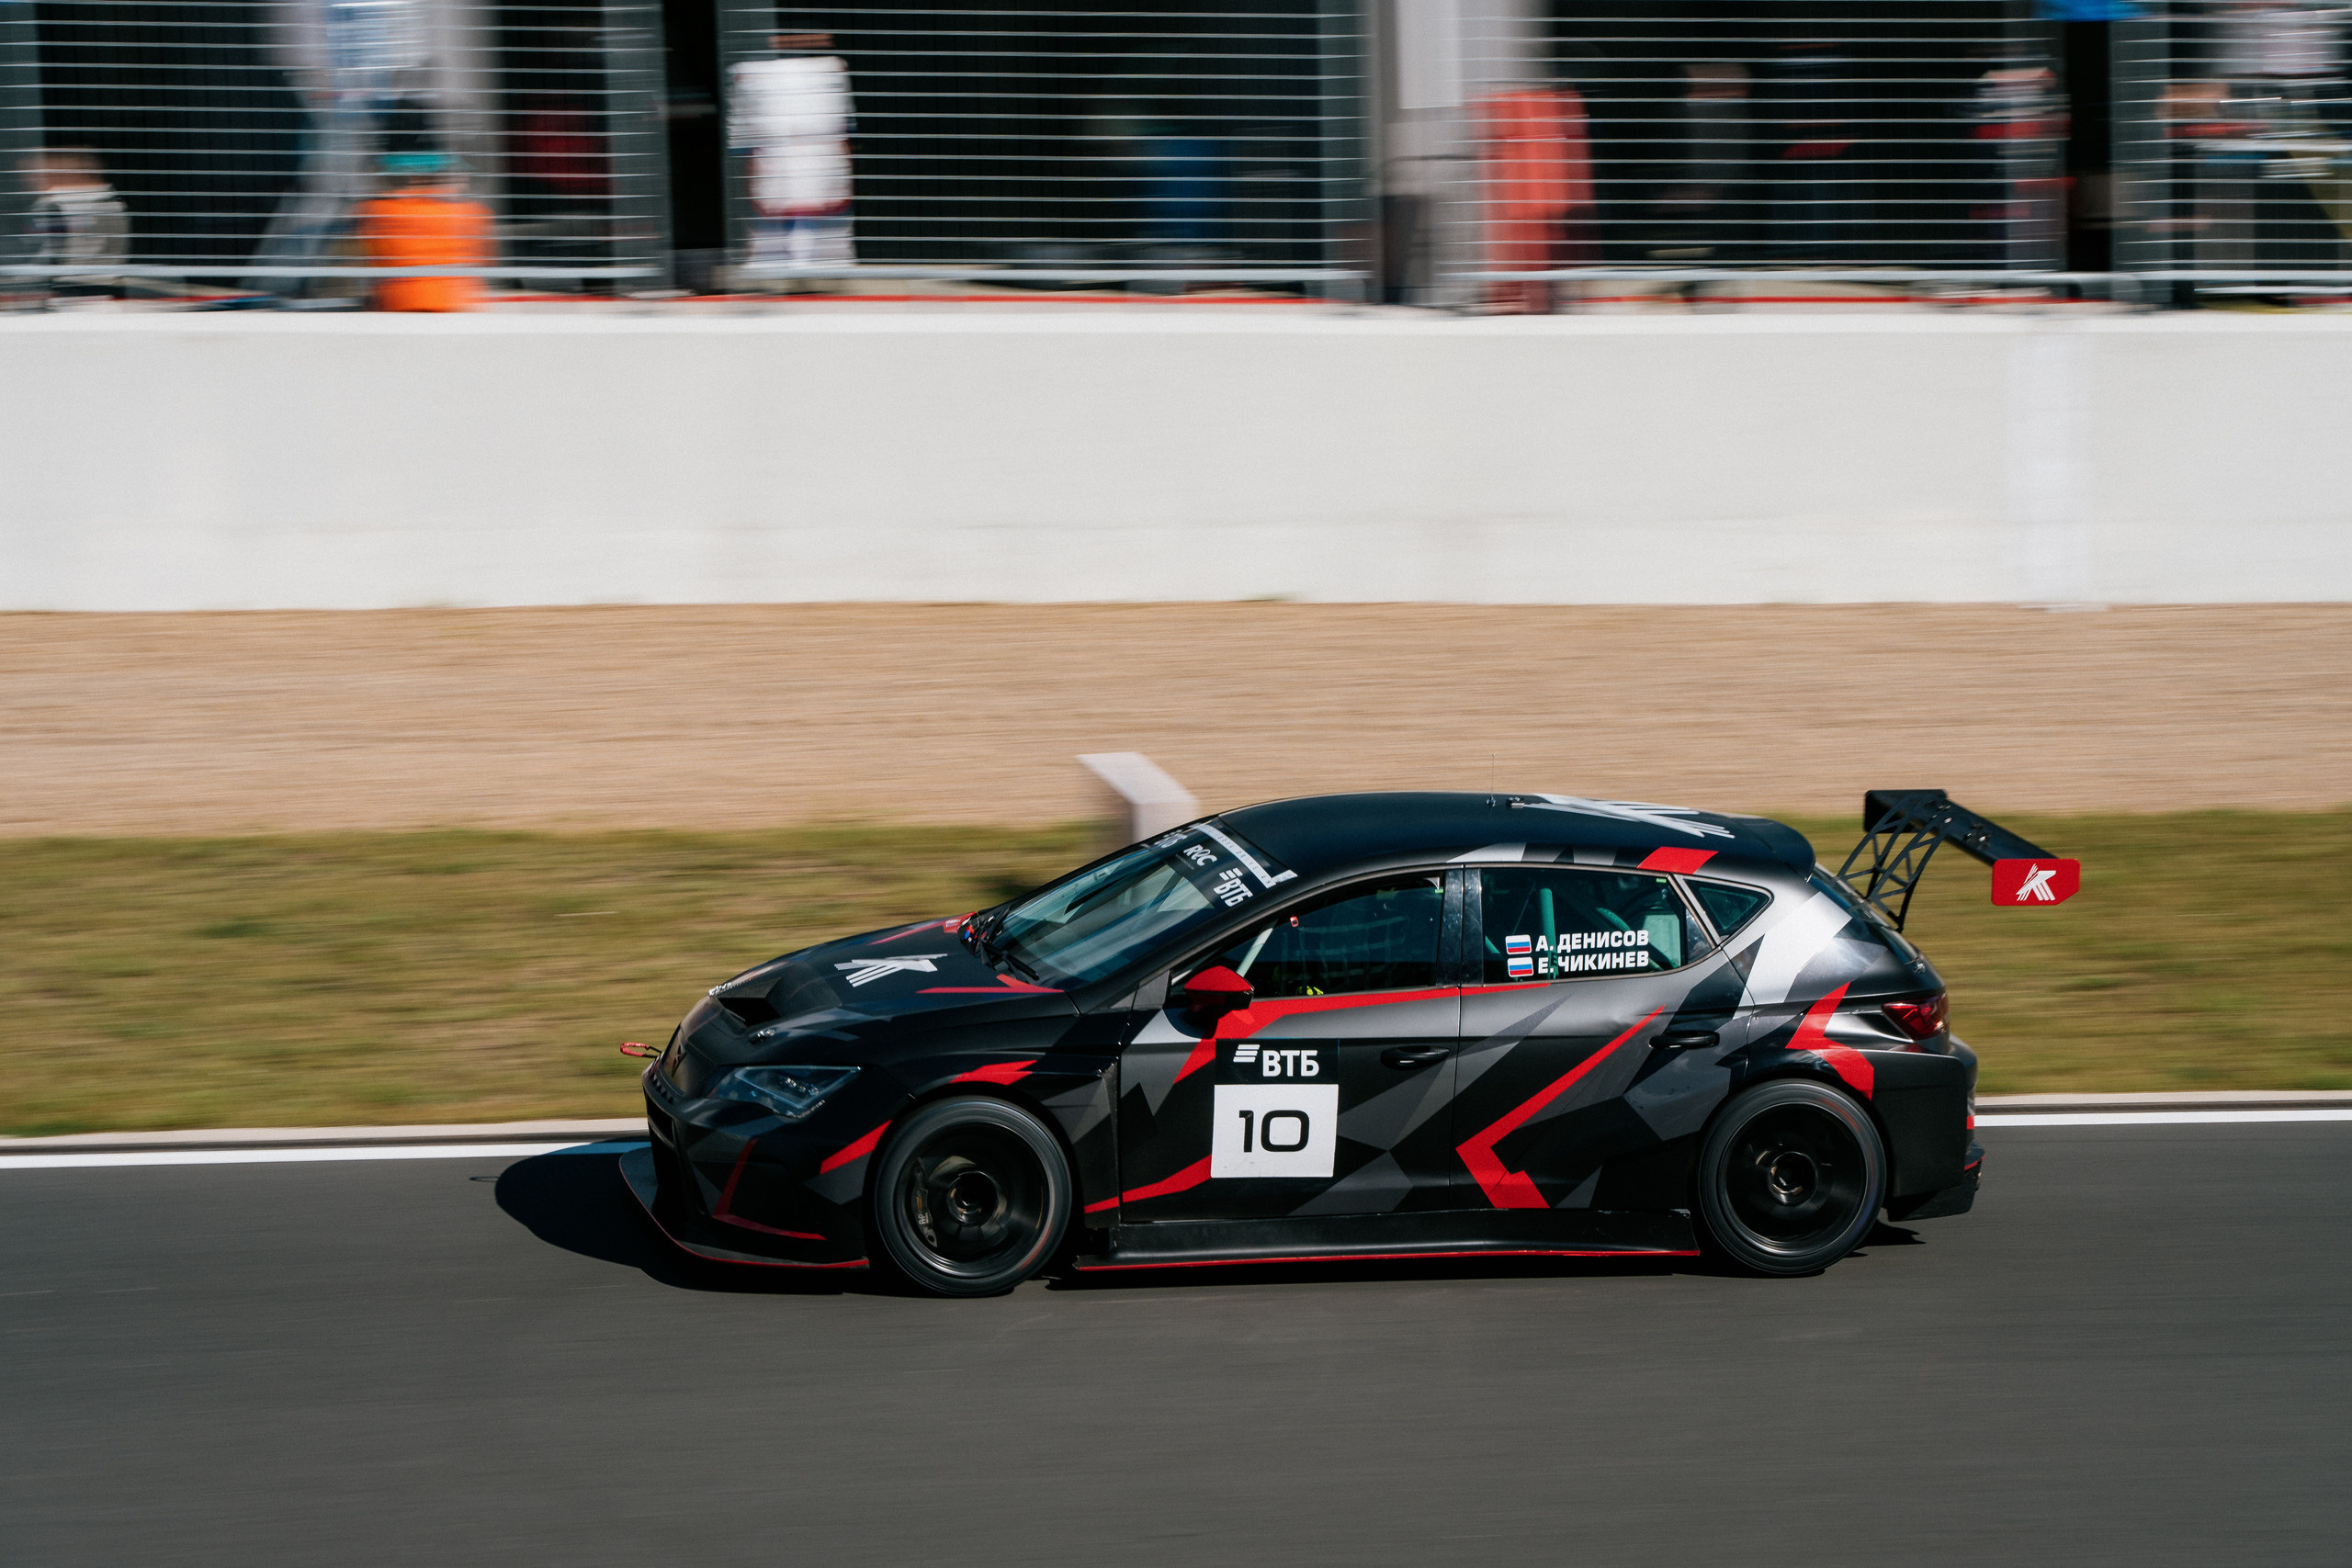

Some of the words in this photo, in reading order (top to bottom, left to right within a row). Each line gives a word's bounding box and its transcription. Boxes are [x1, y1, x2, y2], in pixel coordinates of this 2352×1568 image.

[1535, 935, 1555, 952] А.
[1557, 930, 1649, 953] ДЕНИСОВ
[1538, 957, 1555, 974] Е.
[1558, 951, 1649, 973] ЧИКИНЕВ
[1262, 1050, 1319, 1077] ВТБ
[1238, 1110, 1310, 1153] 10
